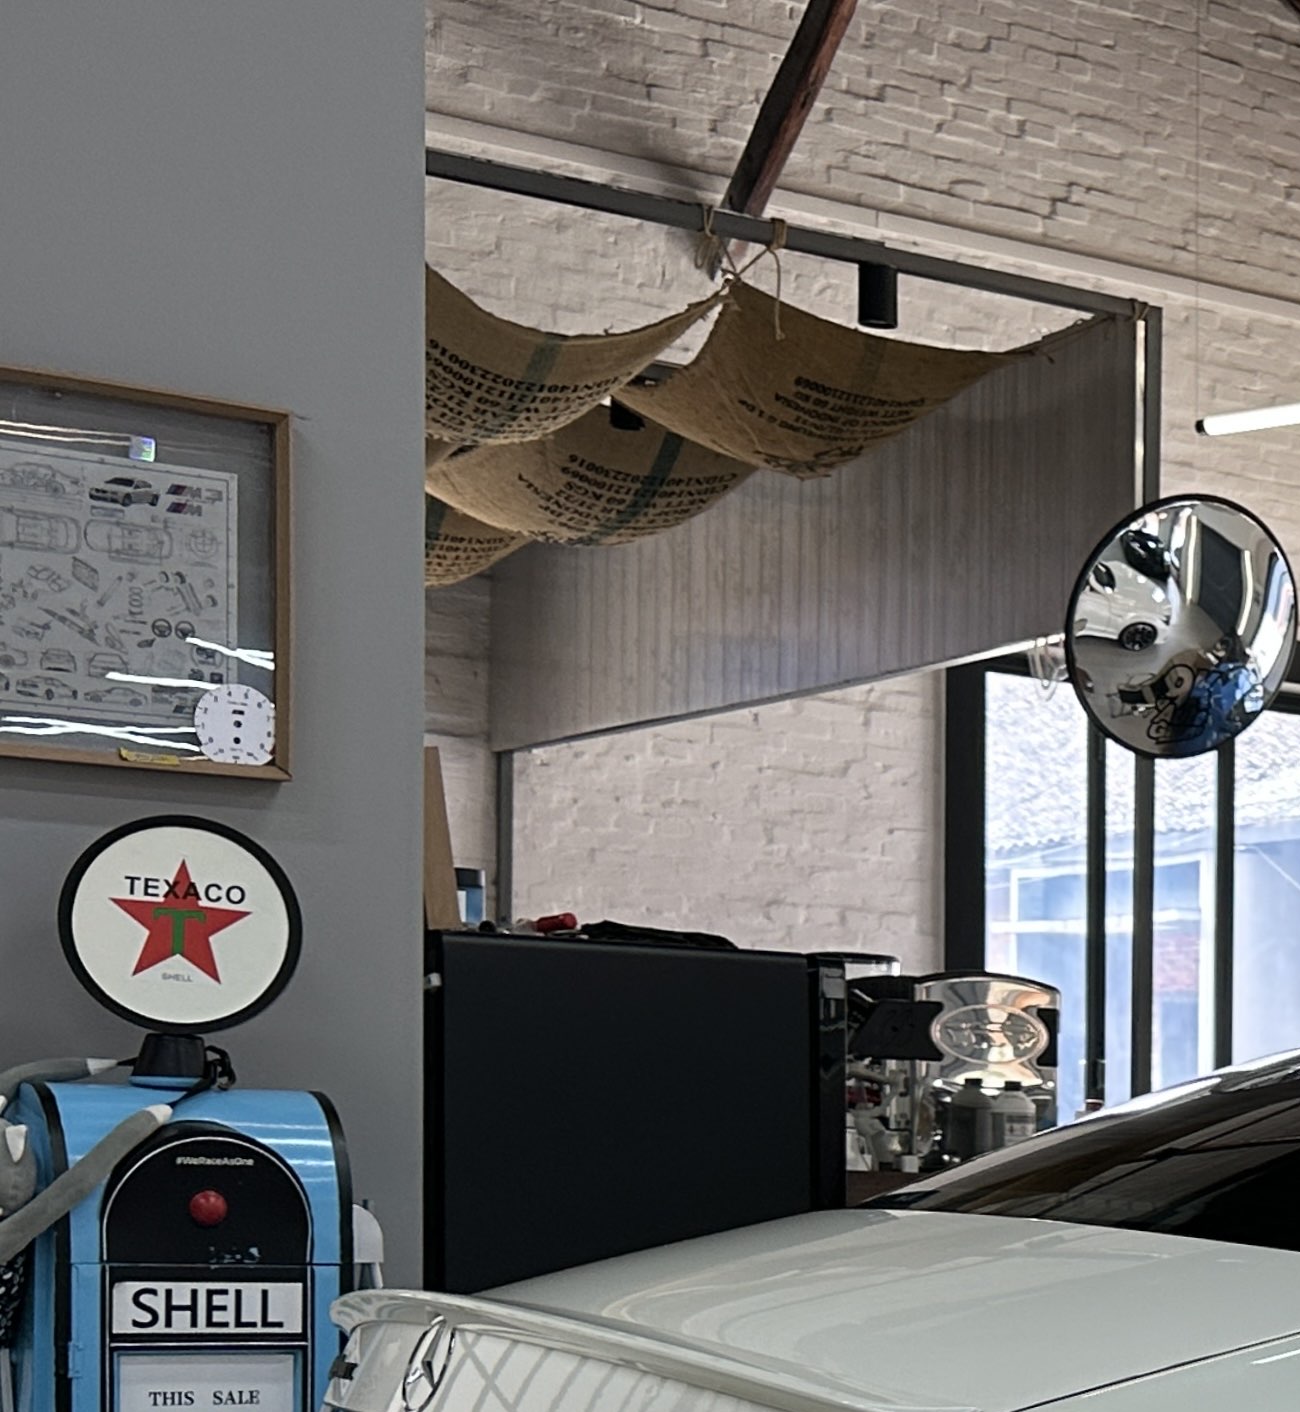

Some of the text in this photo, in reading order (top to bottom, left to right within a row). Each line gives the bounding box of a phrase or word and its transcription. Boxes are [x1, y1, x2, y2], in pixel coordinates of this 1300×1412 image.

[774, 392, 839, 424] INDONESIA
[563, 480, 603, 502] KGS
[124, 875, 247, 905] TEXACO
[175, 1156, 254, 1166] #WeRaceAsOne
[131, 1288, 285, 1329] SHELL
[148, 1389, 261, 1407] THIS SALE
